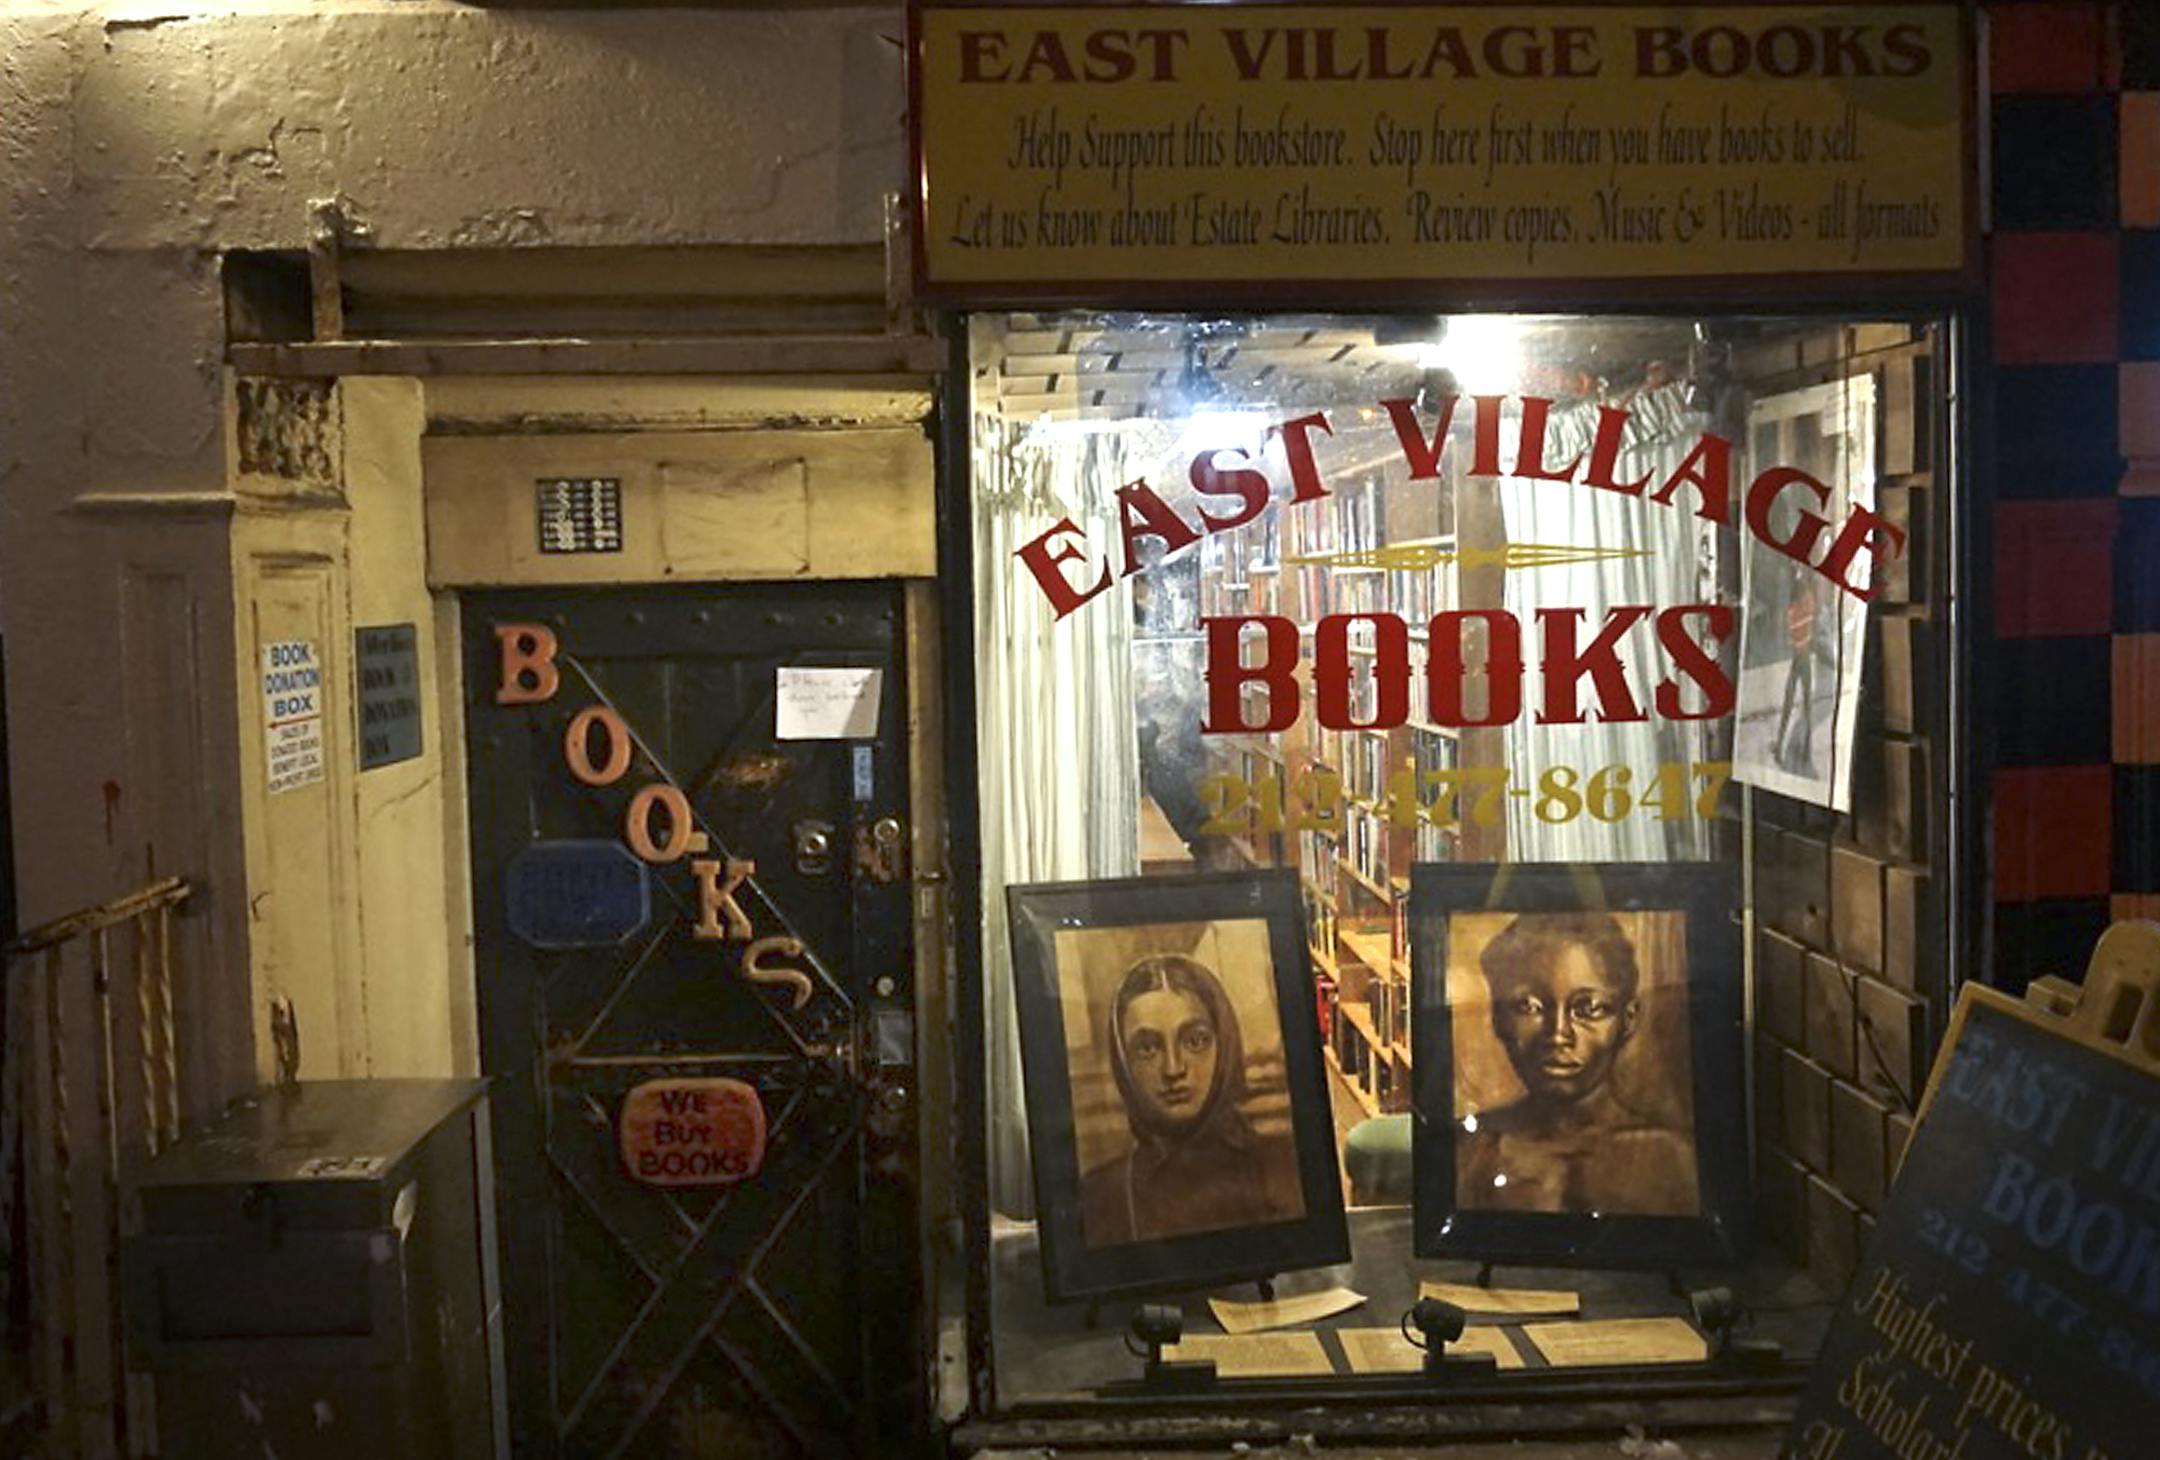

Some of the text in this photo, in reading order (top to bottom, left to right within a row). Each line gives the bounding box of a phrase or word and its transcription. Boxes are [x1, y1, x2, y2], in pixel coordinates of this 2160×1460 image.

[958, 24, 1932, 84] EAST VILLAGE BOOKS
[1007, 106, 1072, 191] Help
[1080, 113, 1175, 191] Support
[1184, 103, 1225, 168] this
[1234, 102, 1353, 168] bookstore.
[1370, 110, 1422, 188] Stop
[1431, 102, 1480, 166] here
[1484, 102, 1535, 188] first
[1541, 102, 1601, 166] when
[1608, 125, 1649, 188] you
[1658, 101, 1712, 165] have
[1719, 101, 1785, 165] books
[1793, 119, 1813, 163] to
[951, 194, 993, 248] Let
[1002, 207, 1027, 248] us
[1037, 185, 1101, 247] know
[1110, 188, 1177, 247] about
[1184, 192, 1262, 247] Estate
[1271, 184, 1391, 245] Libraries.
[1407, 190, 1497, 244] Review
[1587, 186, 1667, 243] Music
[1674, 186, 1705, 243] &
[1716, 178, 1793, 241] Videos
[1817, 178, 1848, 239] all
[1849, 178, 1941, 264] formats
[1014, 395, 1907, 622] EAST VILLAGE
[265, 666, 321, 695] DONATION
[270, 643, 312, 668] BOOK
[1200, 604, 1736, 734] BOOKS
[274, 693, 314, 718] BOX
[495, 623, 812, 1009] BOOKS
[655, 1120, 712, 1147] BUY
[661, 1090, 706, 1115] WE
[639, 1150, 749, 1176] BOOKS
[1916, 1208, 1990, 1276] 212
[1853, 1264, 2073, 1460] Highest prices
